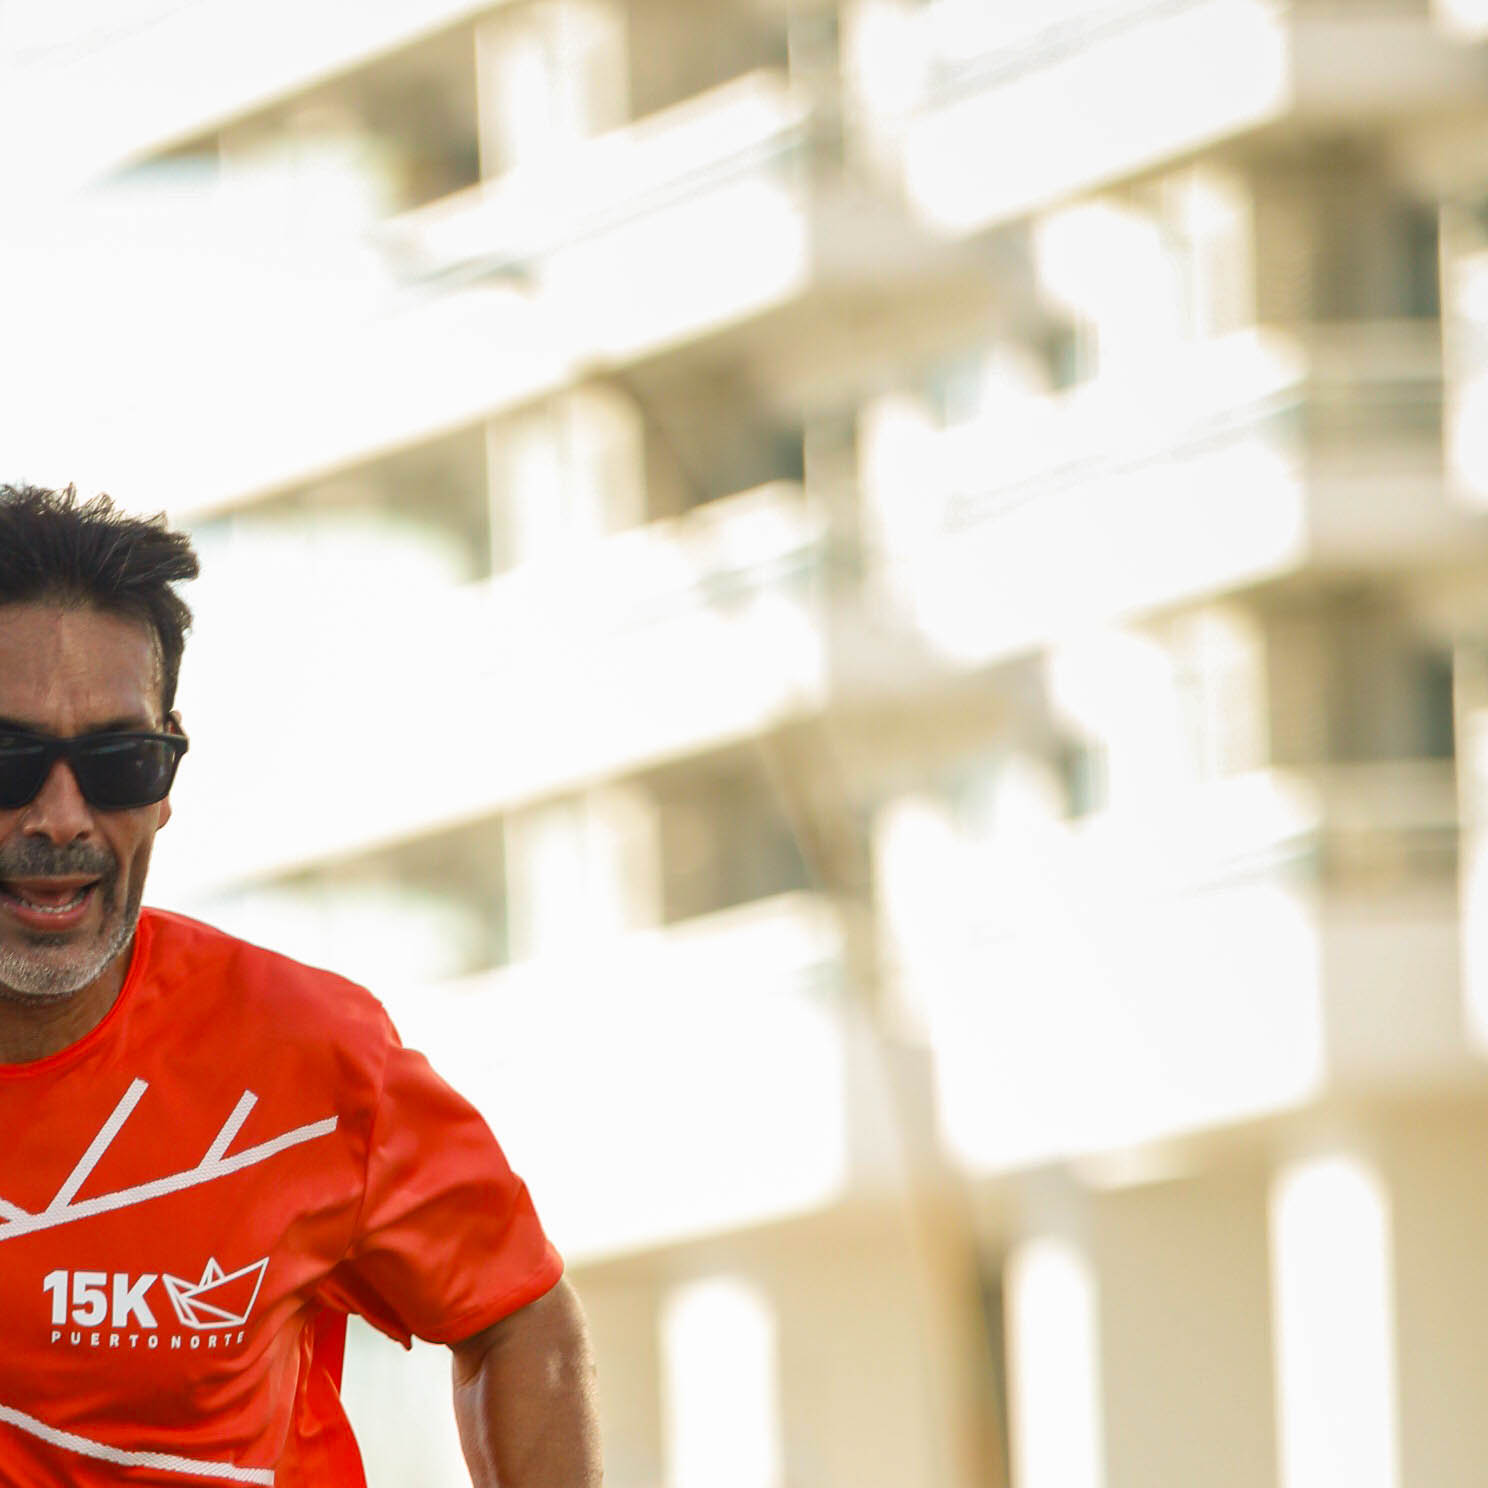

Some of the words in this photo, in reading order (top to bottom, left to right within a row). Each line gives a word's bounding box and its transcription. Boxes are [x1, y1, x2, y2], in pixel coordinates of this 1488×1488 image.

[43, 1270, 159, 1328] 15K
[51, 1331, 159, 1349] PUERTO
[170, 1331, 245, 1349] NORTE
